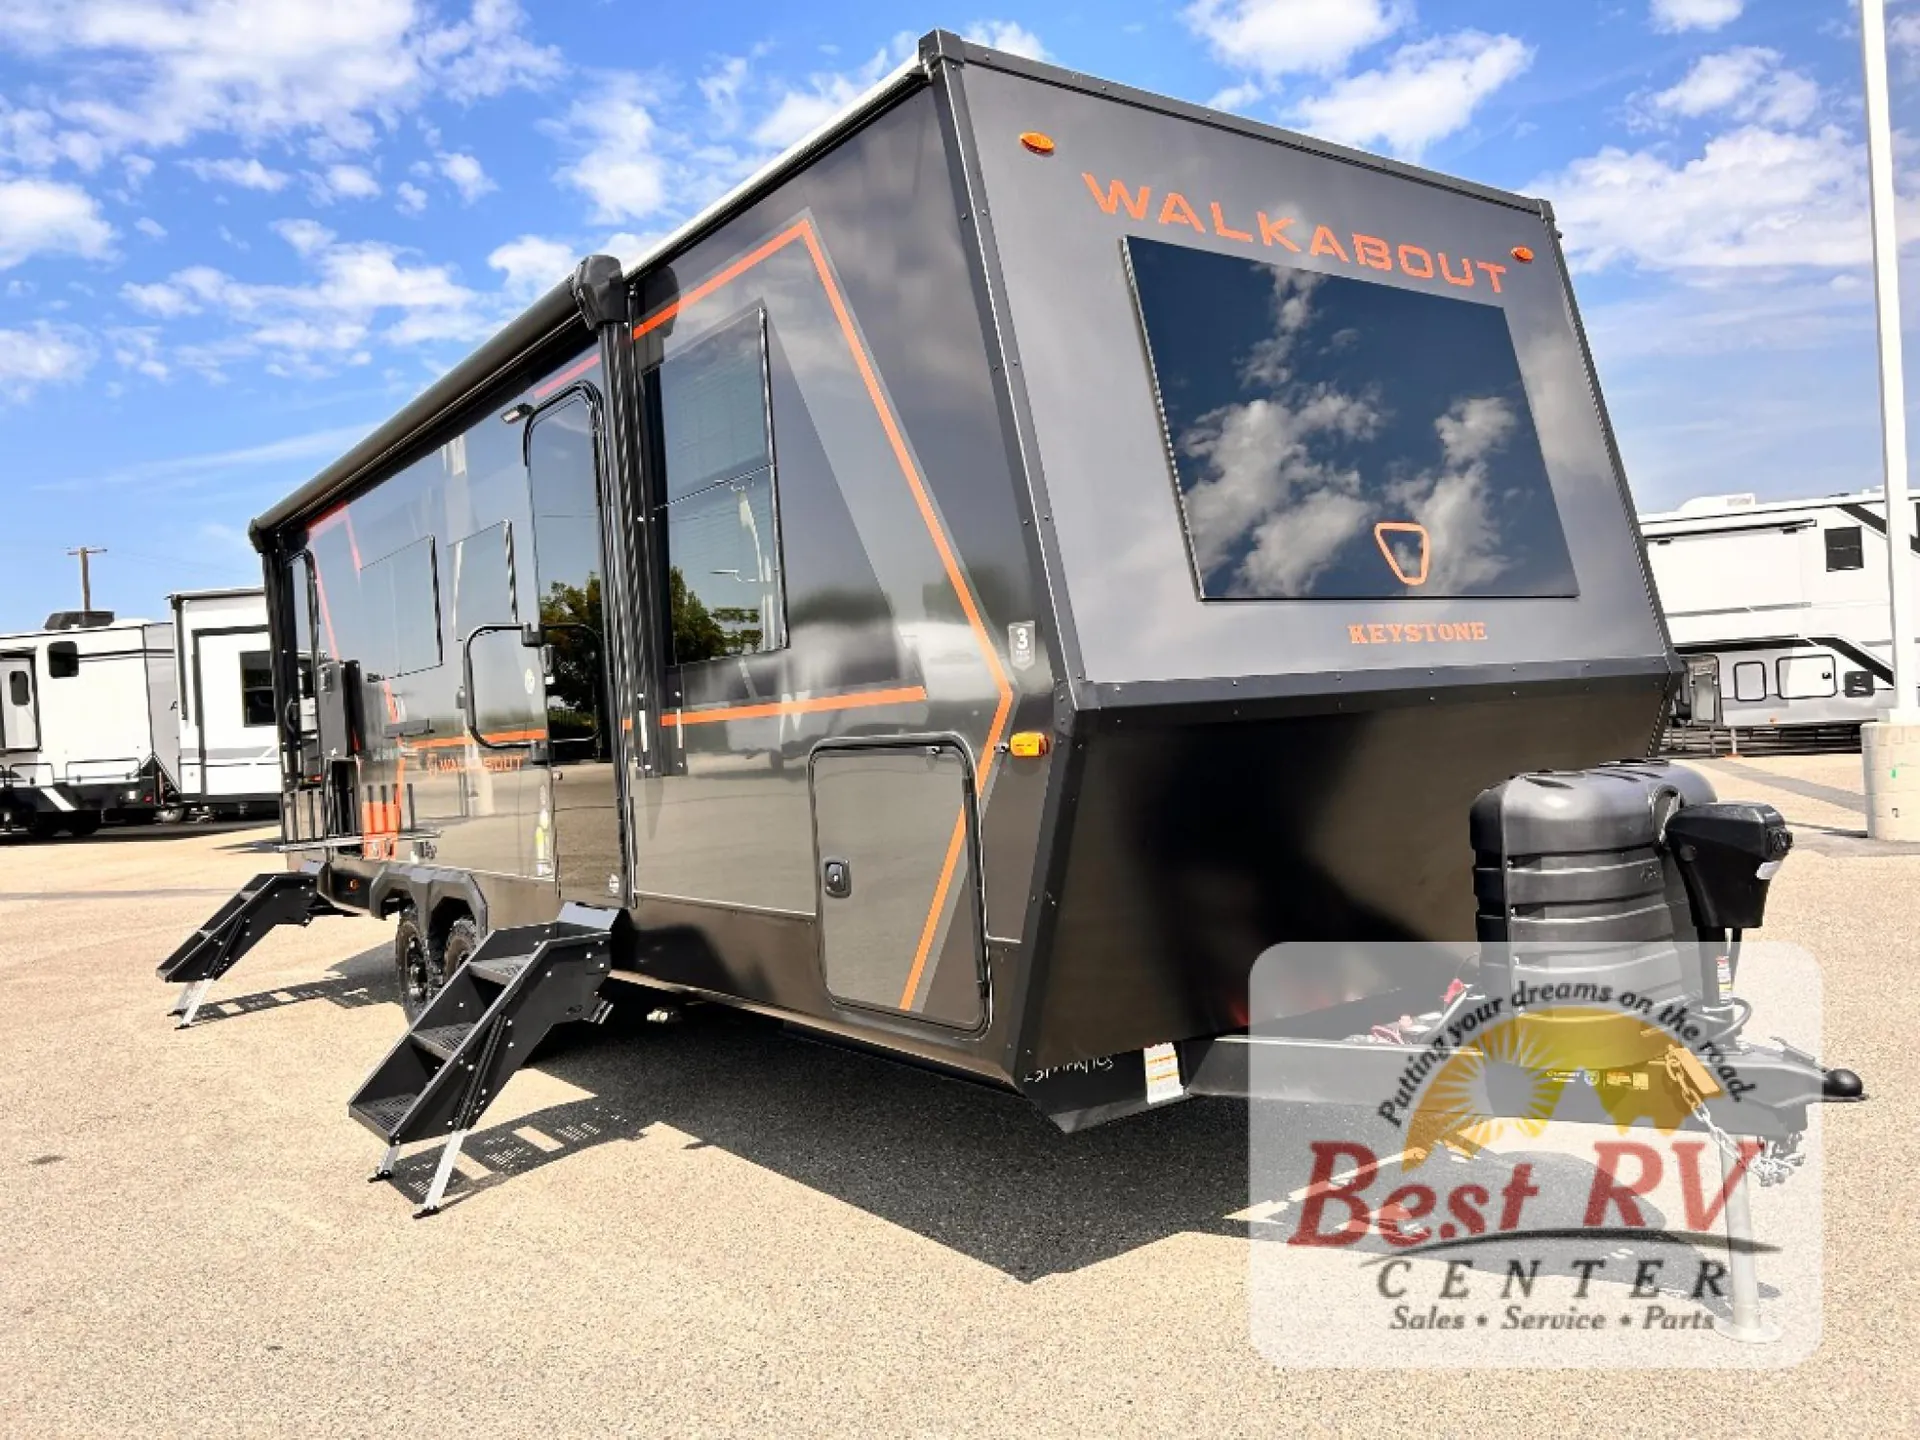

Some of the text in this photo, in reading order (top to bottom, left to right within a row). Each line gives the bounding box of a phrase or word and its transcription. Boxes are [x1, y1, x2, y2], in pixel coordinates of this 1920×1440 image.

[1081, 172, 1507, 293] WALKABOUT
[1016, 627, 1029, 650] 3
[1347, 622, 1488, 644] KEYSTONE
